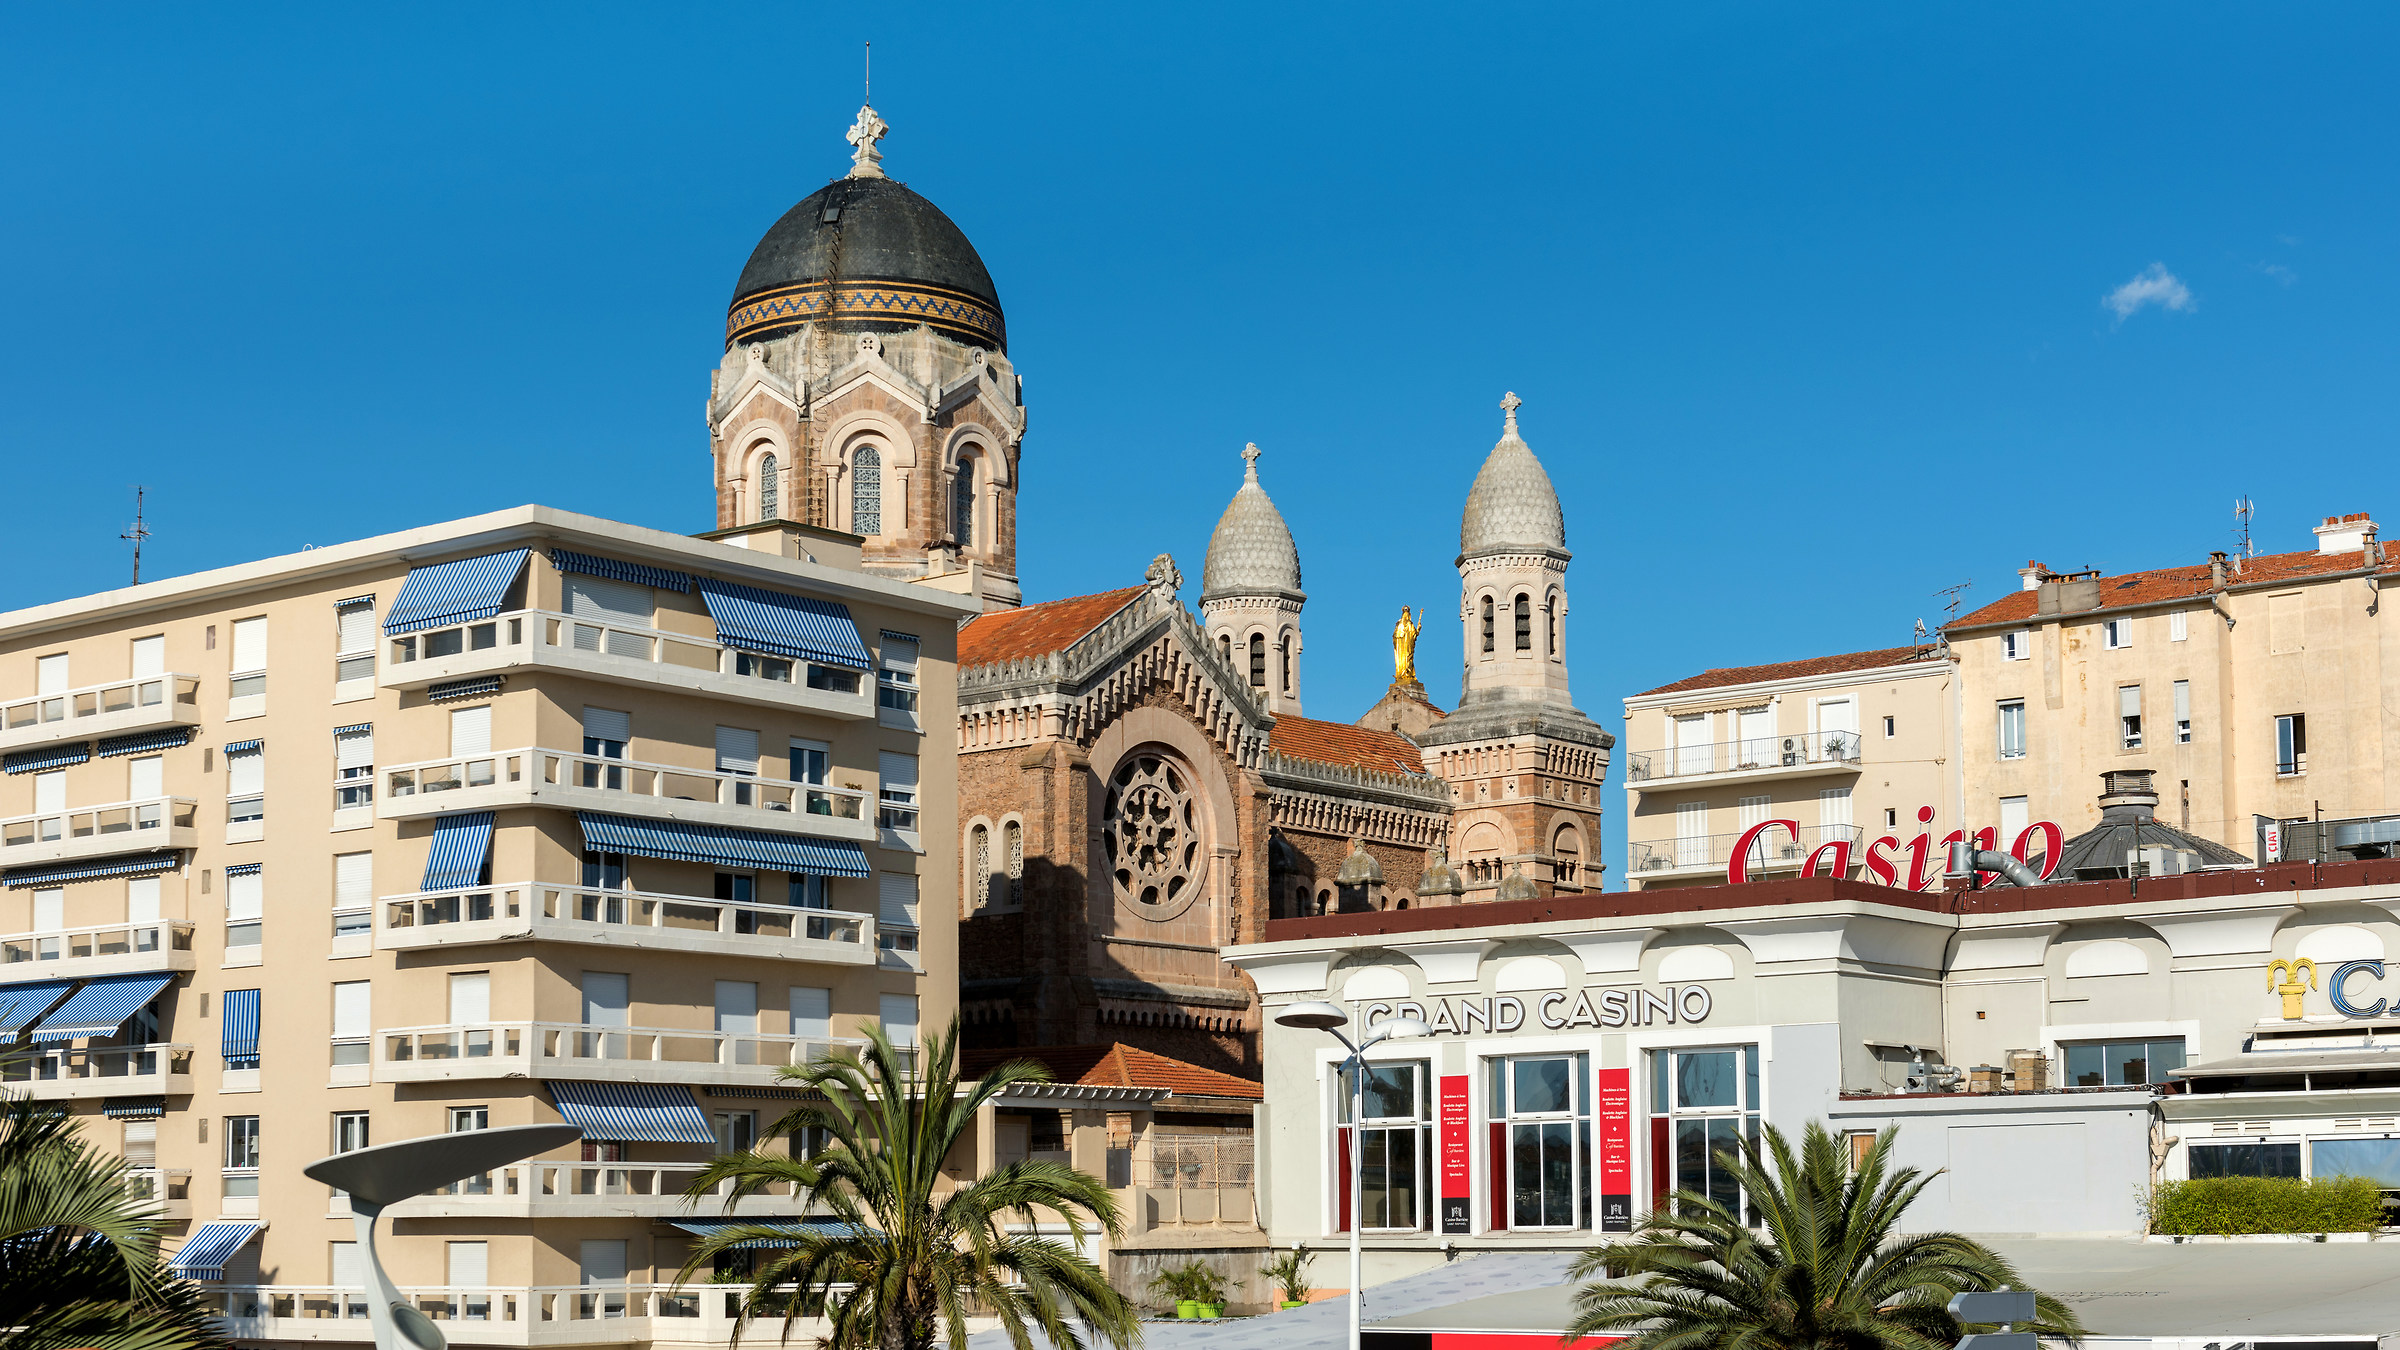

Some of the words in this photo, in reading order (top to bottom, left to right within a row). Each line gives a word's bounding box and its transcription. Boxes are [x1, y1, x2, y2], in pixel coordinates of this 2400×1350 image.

[2267, 831, 2278, 852] CIAT
[1537, 984, 1712, 1030] CASINO
[2329, 960, 2400, 1019] C
